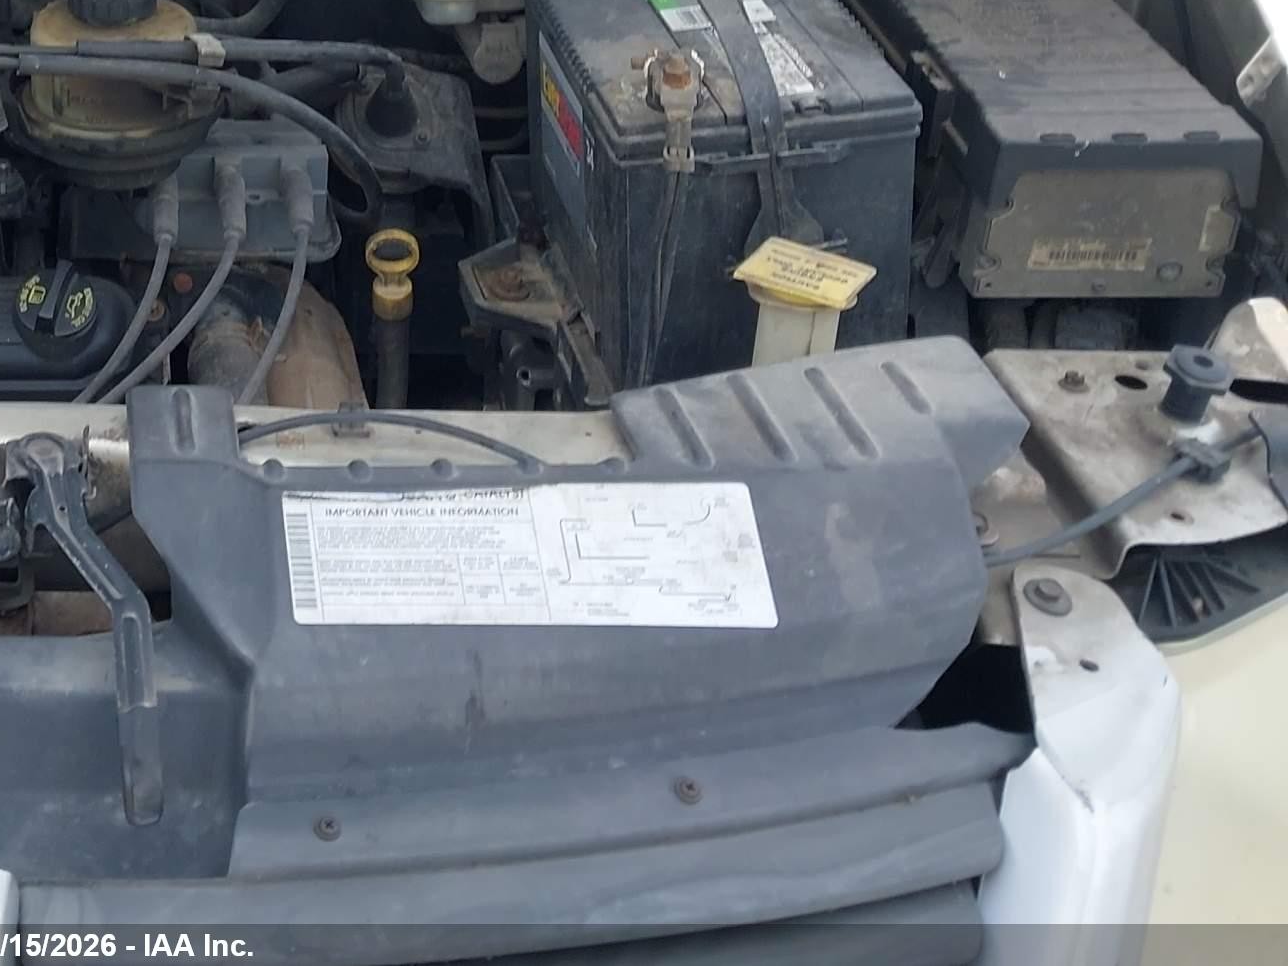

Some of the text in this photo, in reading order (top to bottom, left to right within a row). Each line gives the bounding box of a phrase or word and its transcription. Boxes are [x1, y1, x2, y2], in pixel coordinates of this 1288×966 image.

[325, 507, 520, 517] IMPORTANT VEHICLE INFORMATION
